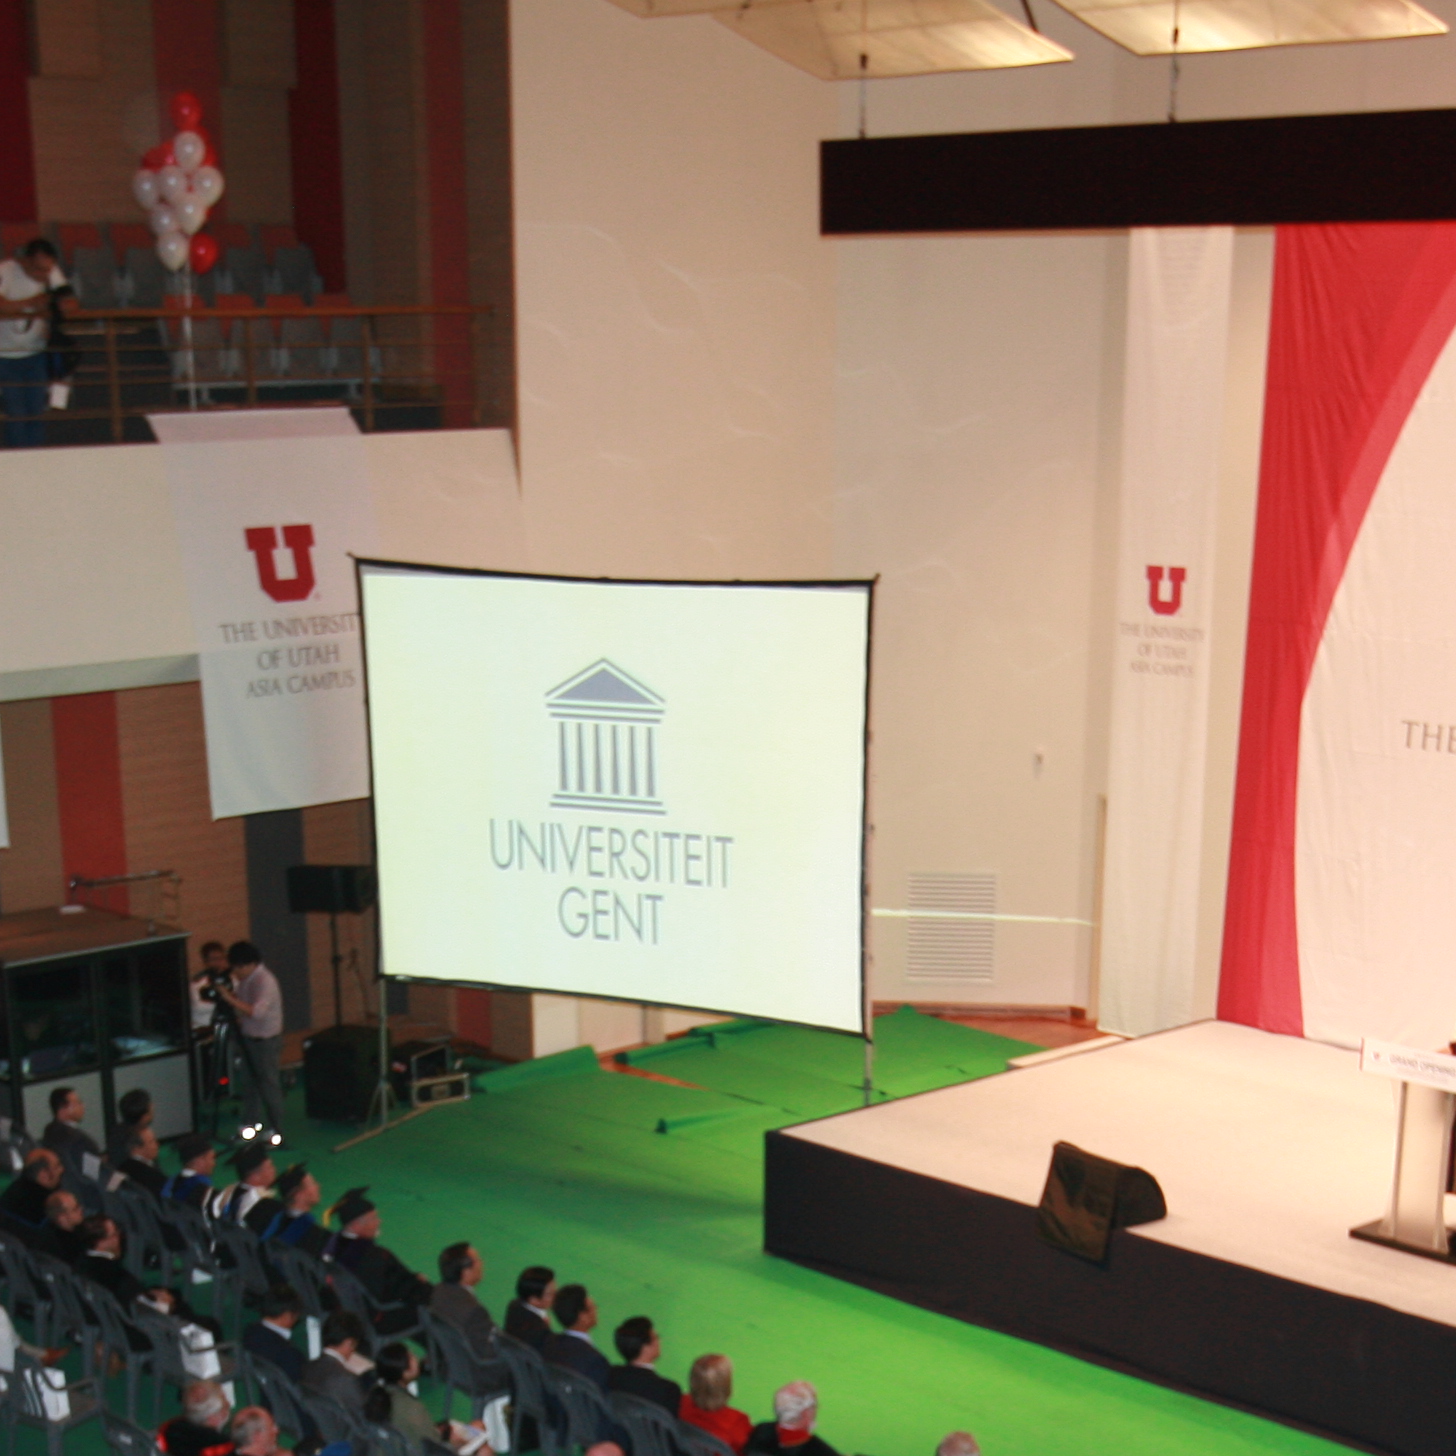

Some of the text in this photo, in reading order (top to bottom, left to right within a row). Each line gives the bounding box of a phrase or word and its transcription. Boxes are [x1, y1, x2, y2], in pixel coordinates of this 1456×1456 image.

[244, 523, 317, 604] U
[1146, 565, 1187, 616] U
[219, 612, 359, 643] THE UNIVERSIT
[256, 643, 340, 670] OF UTAH
[247, 668, 357, 699] ASIA CAMPUS
[489, 817, 734, 889] UNIVERSITEIT
[558, 886, 665, 945] GENT
